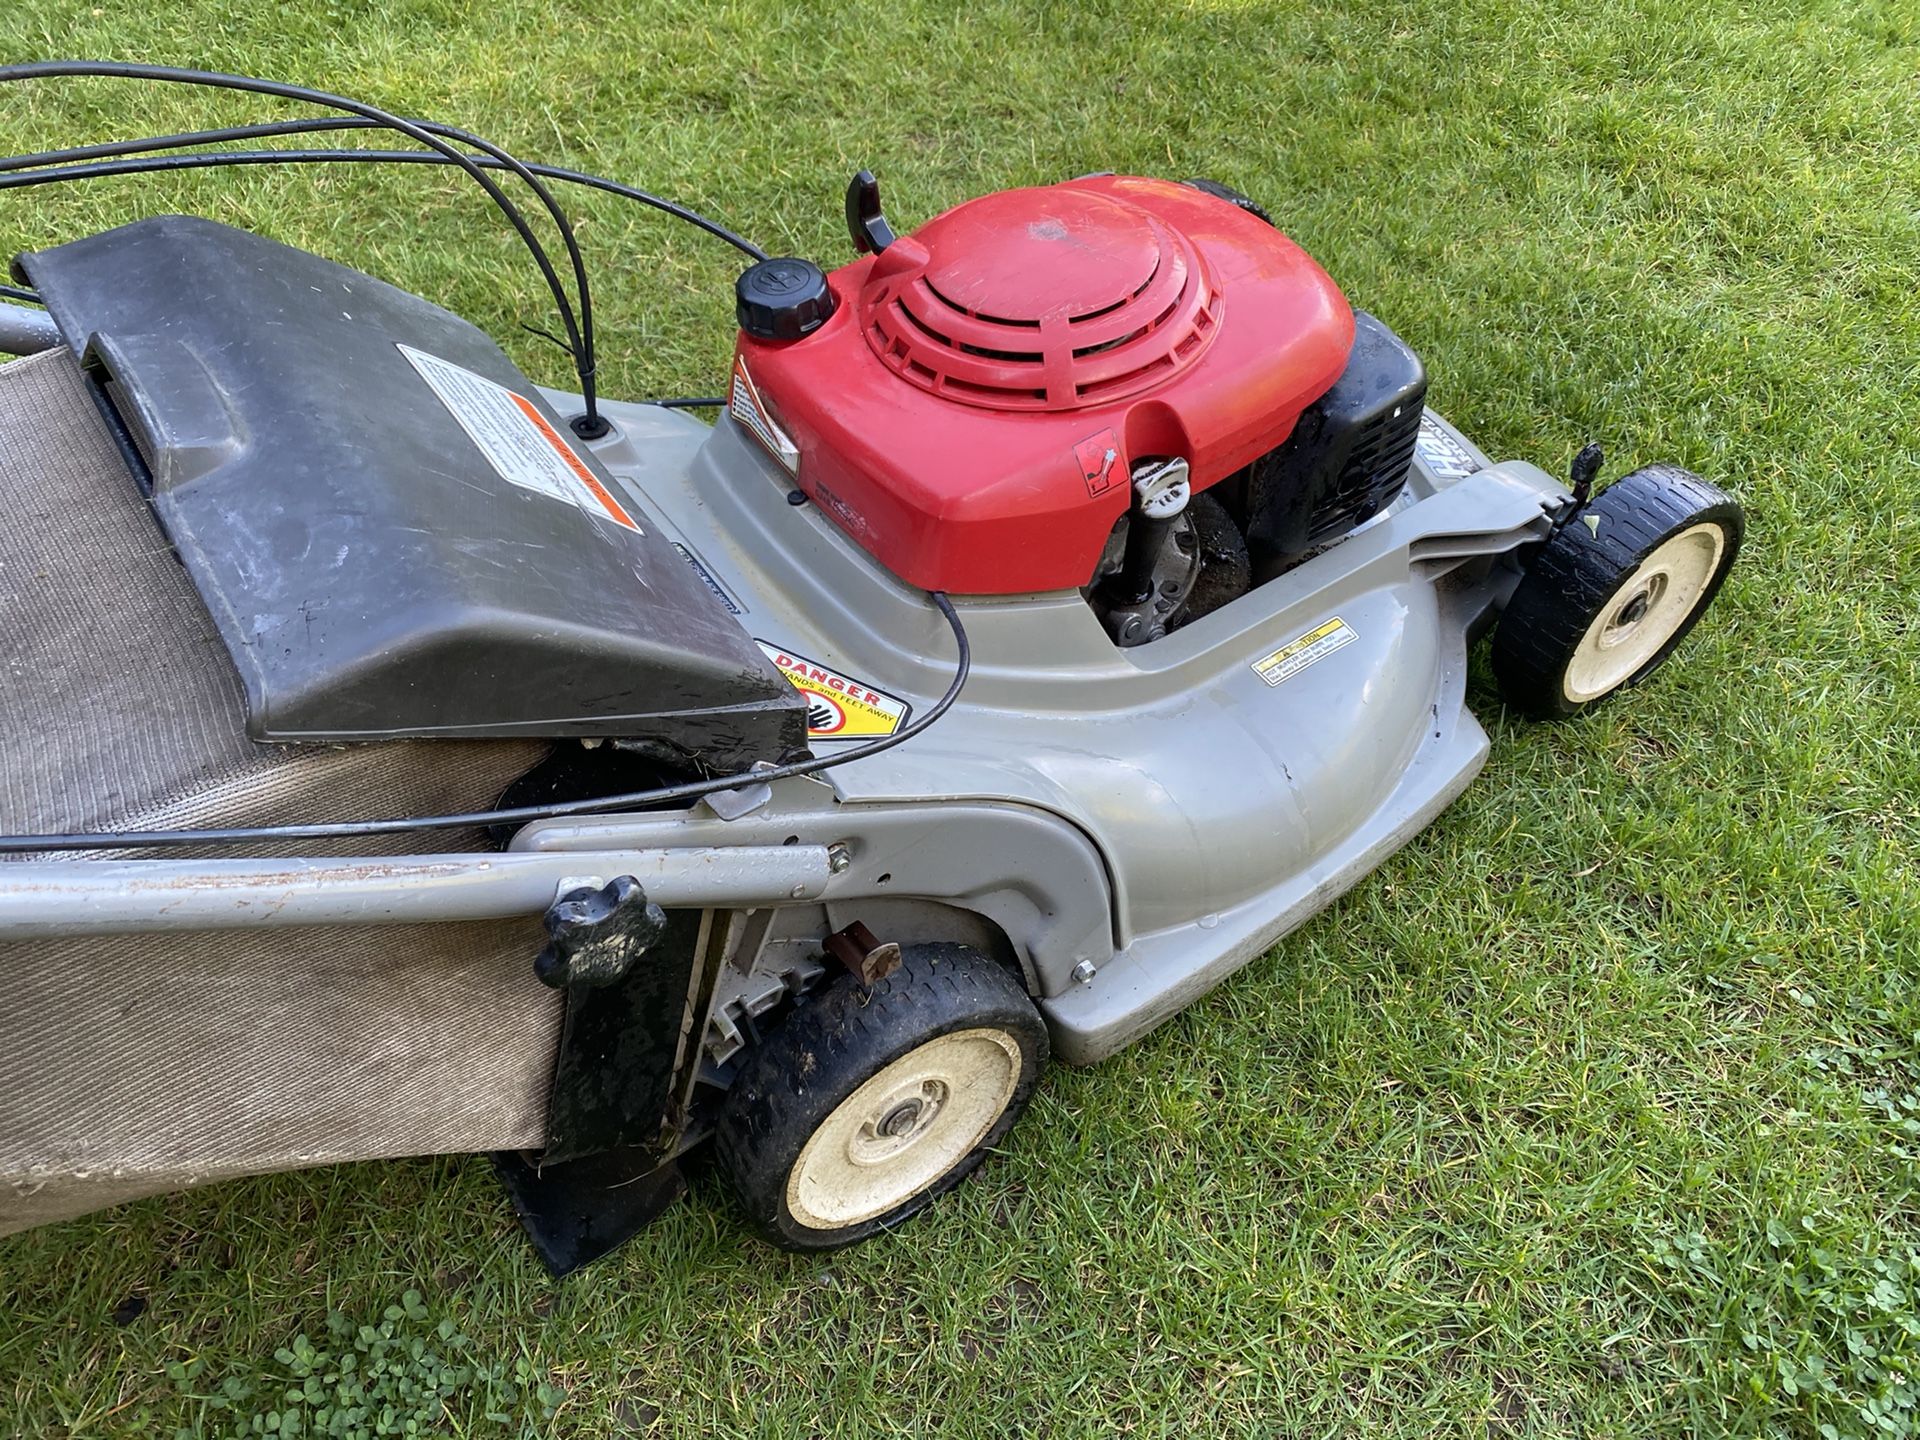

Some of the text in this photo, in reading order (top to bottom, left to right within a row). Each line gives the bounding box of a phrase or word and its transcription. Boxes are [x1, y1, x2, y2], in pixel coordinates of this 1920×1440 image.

[775, 655, 881, 706] DANGER
[818, 687, 837, 699] and
[840, 695, 864, 709] FEET
[866, 707, 895, 722] AWAY
